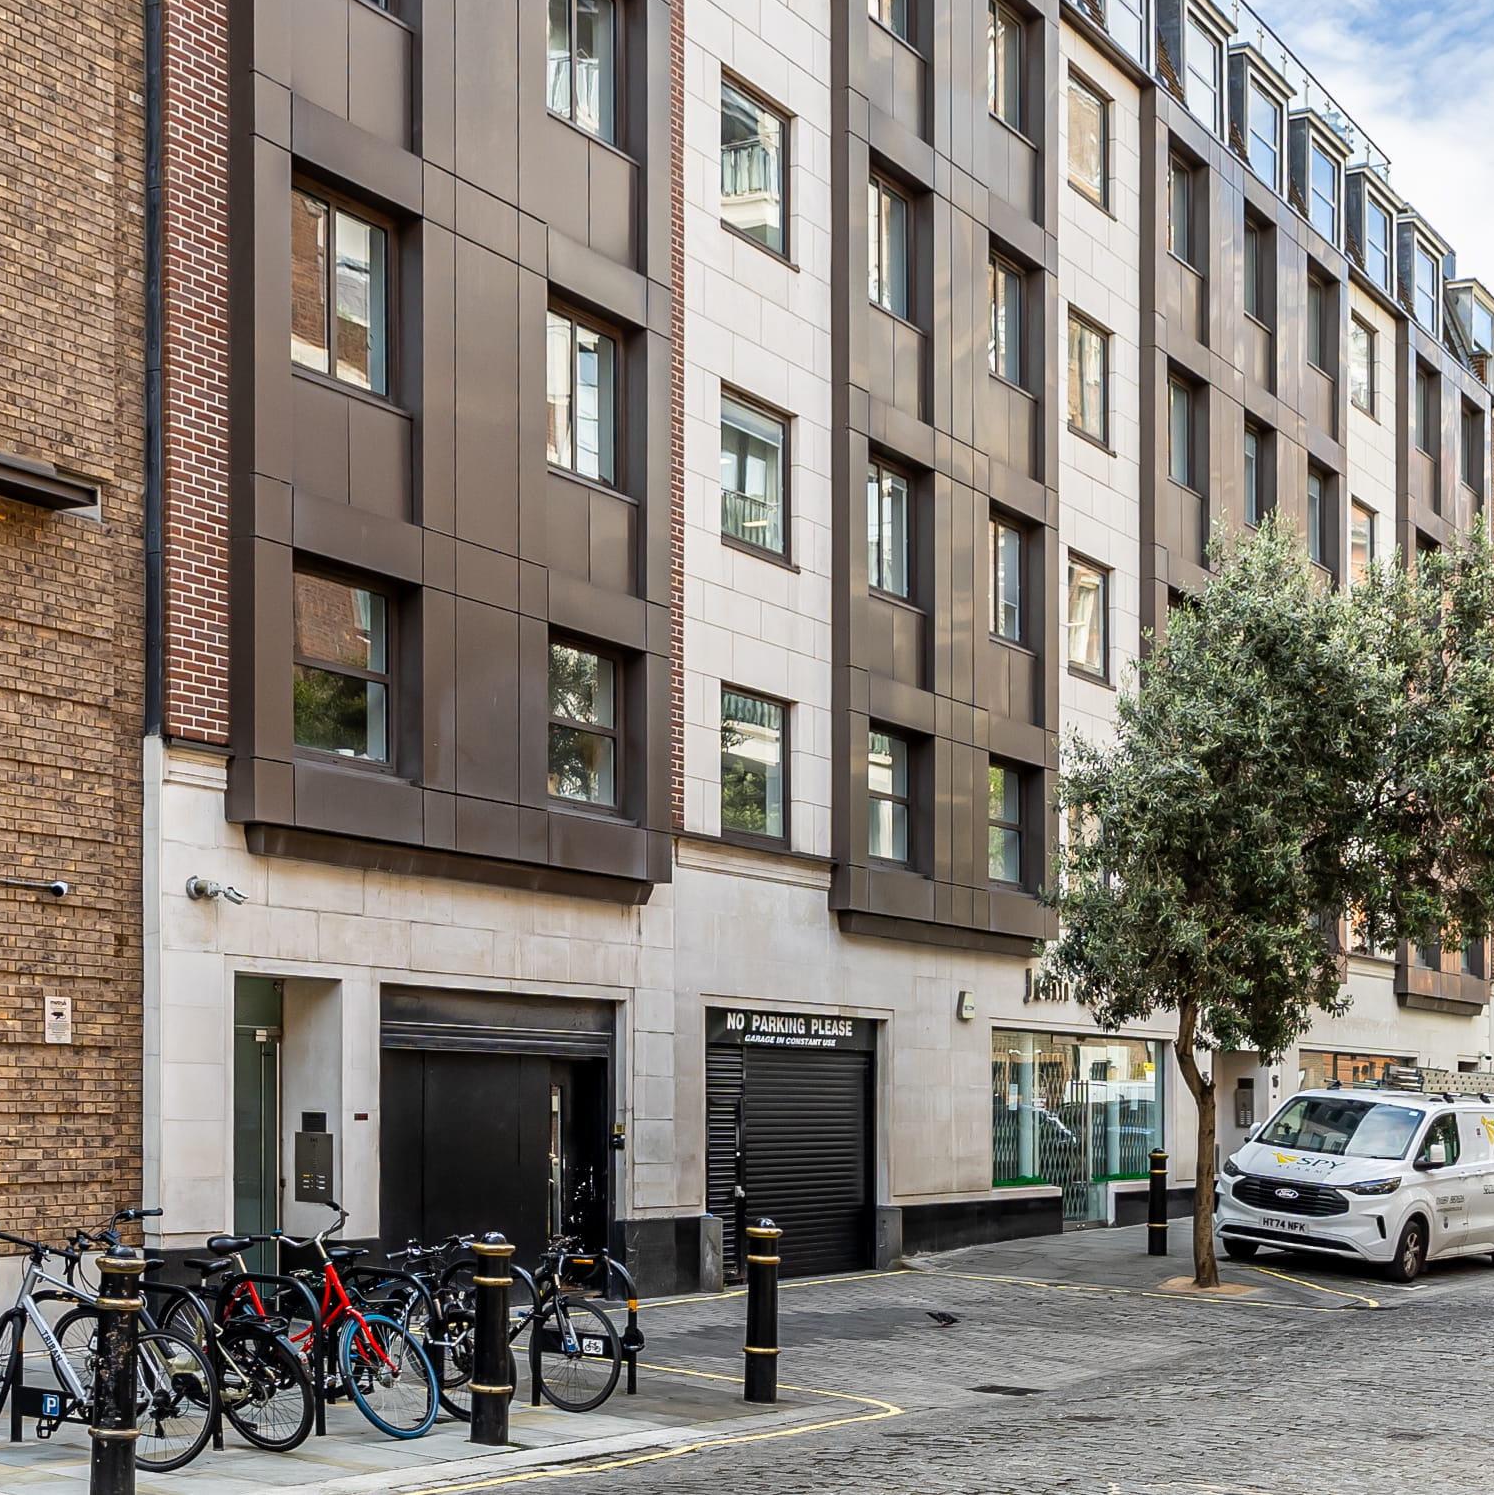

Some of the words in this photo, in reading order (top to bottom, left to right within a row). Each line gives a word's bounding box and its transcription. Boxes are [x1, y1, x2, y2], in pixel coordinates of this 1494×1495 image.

[726, 1012, 745, 1030] NO
[751, 1014, 805, 1035] PARKING
[811, 1018, 853, 1037] PLEASE
[744, 1034, 776, 1043] GARAGE
[776, 1036, 785, 1044] IN
[785, 1037, 823, 1046] CONSTANT
[822, 1039, 837, 1047] USE
[1296, 1157, 1347, 1170] SPY
[1262, 1217, 1286, 1228] HT74
[1287, 1220, 1306, 1231] NFK
[41, 1329, 64, 1362] TRIBAN
[46, 1397, 57, 1413] P
